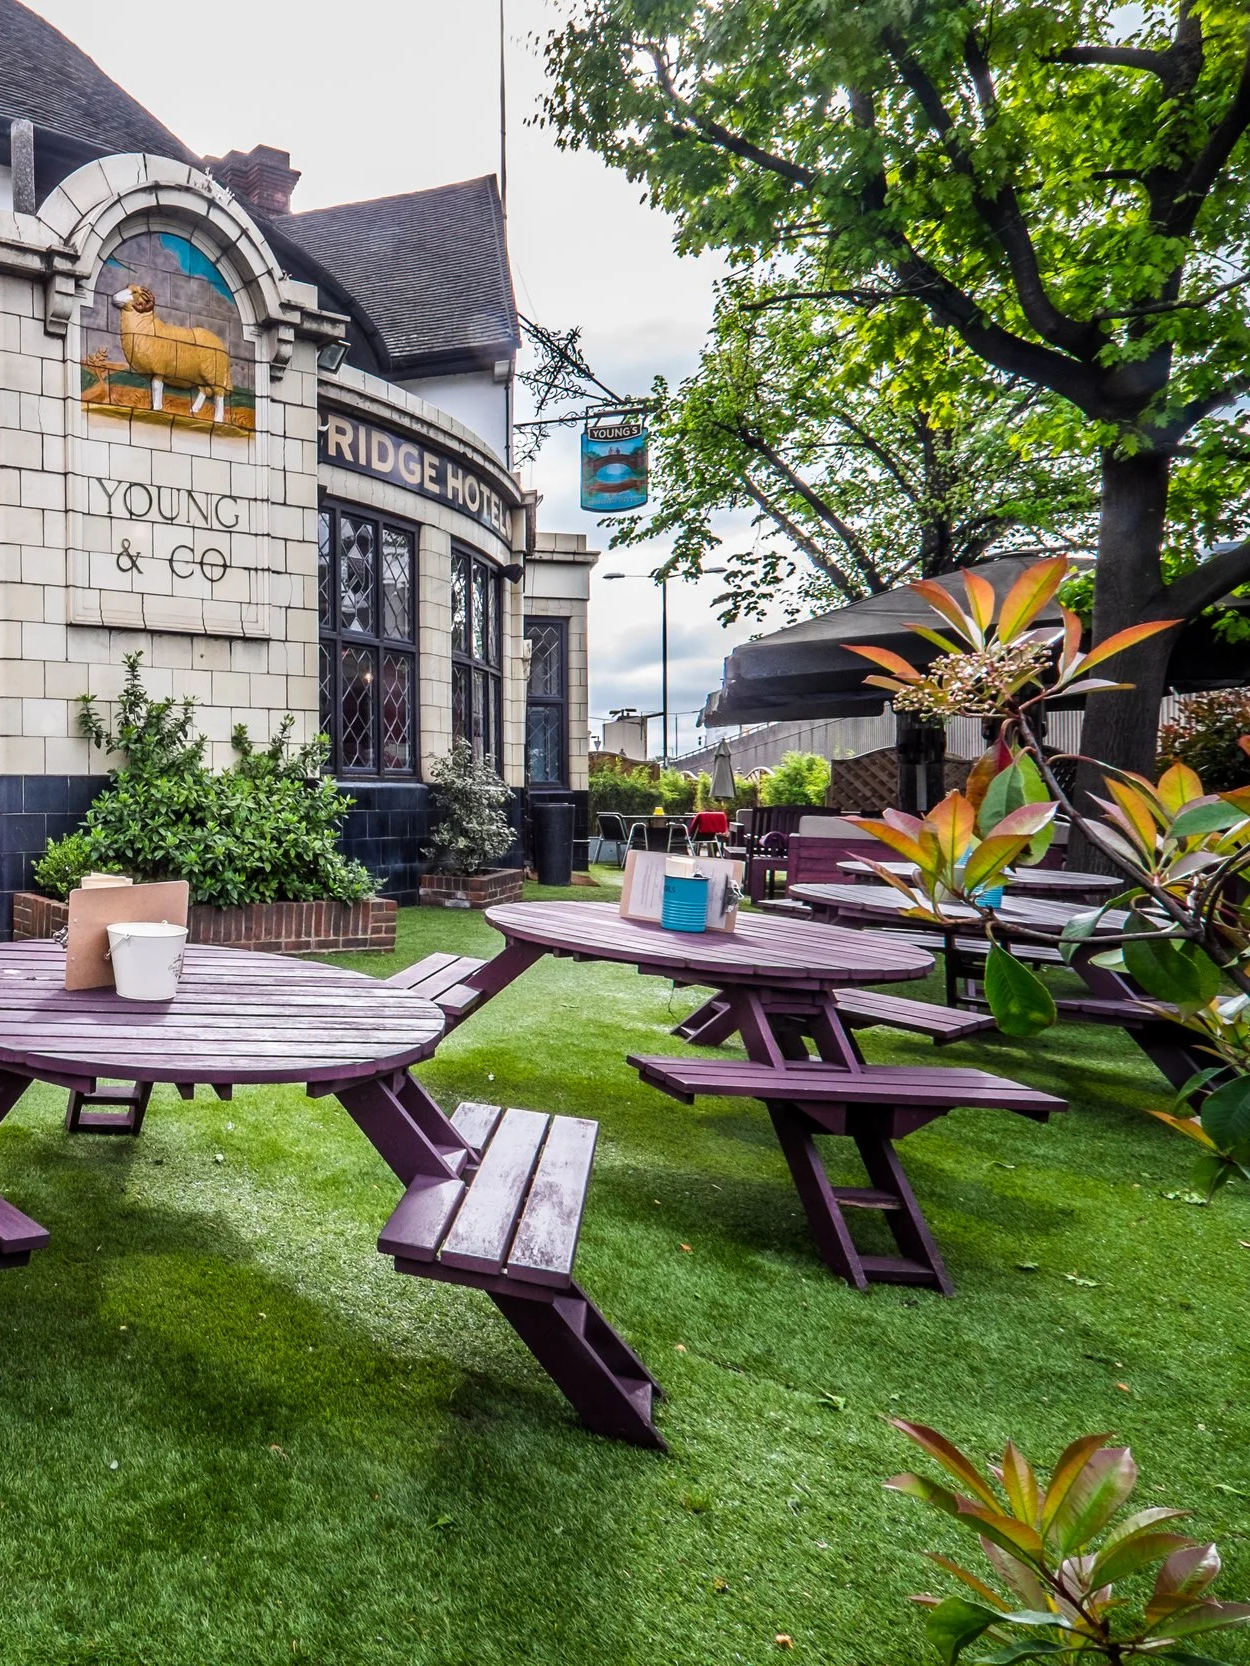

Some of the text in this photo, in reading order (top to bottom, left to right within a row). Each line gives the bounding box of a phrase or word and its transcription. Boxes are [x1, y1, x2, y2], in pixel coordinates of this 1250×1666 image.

[592, 425, 638, 439] YOUNG'S
[317, 412, 507, 538] RIDGE HOTEL
[95, 477, 240, 529] YOUNG
[116, 537, 228, 583] & CO
